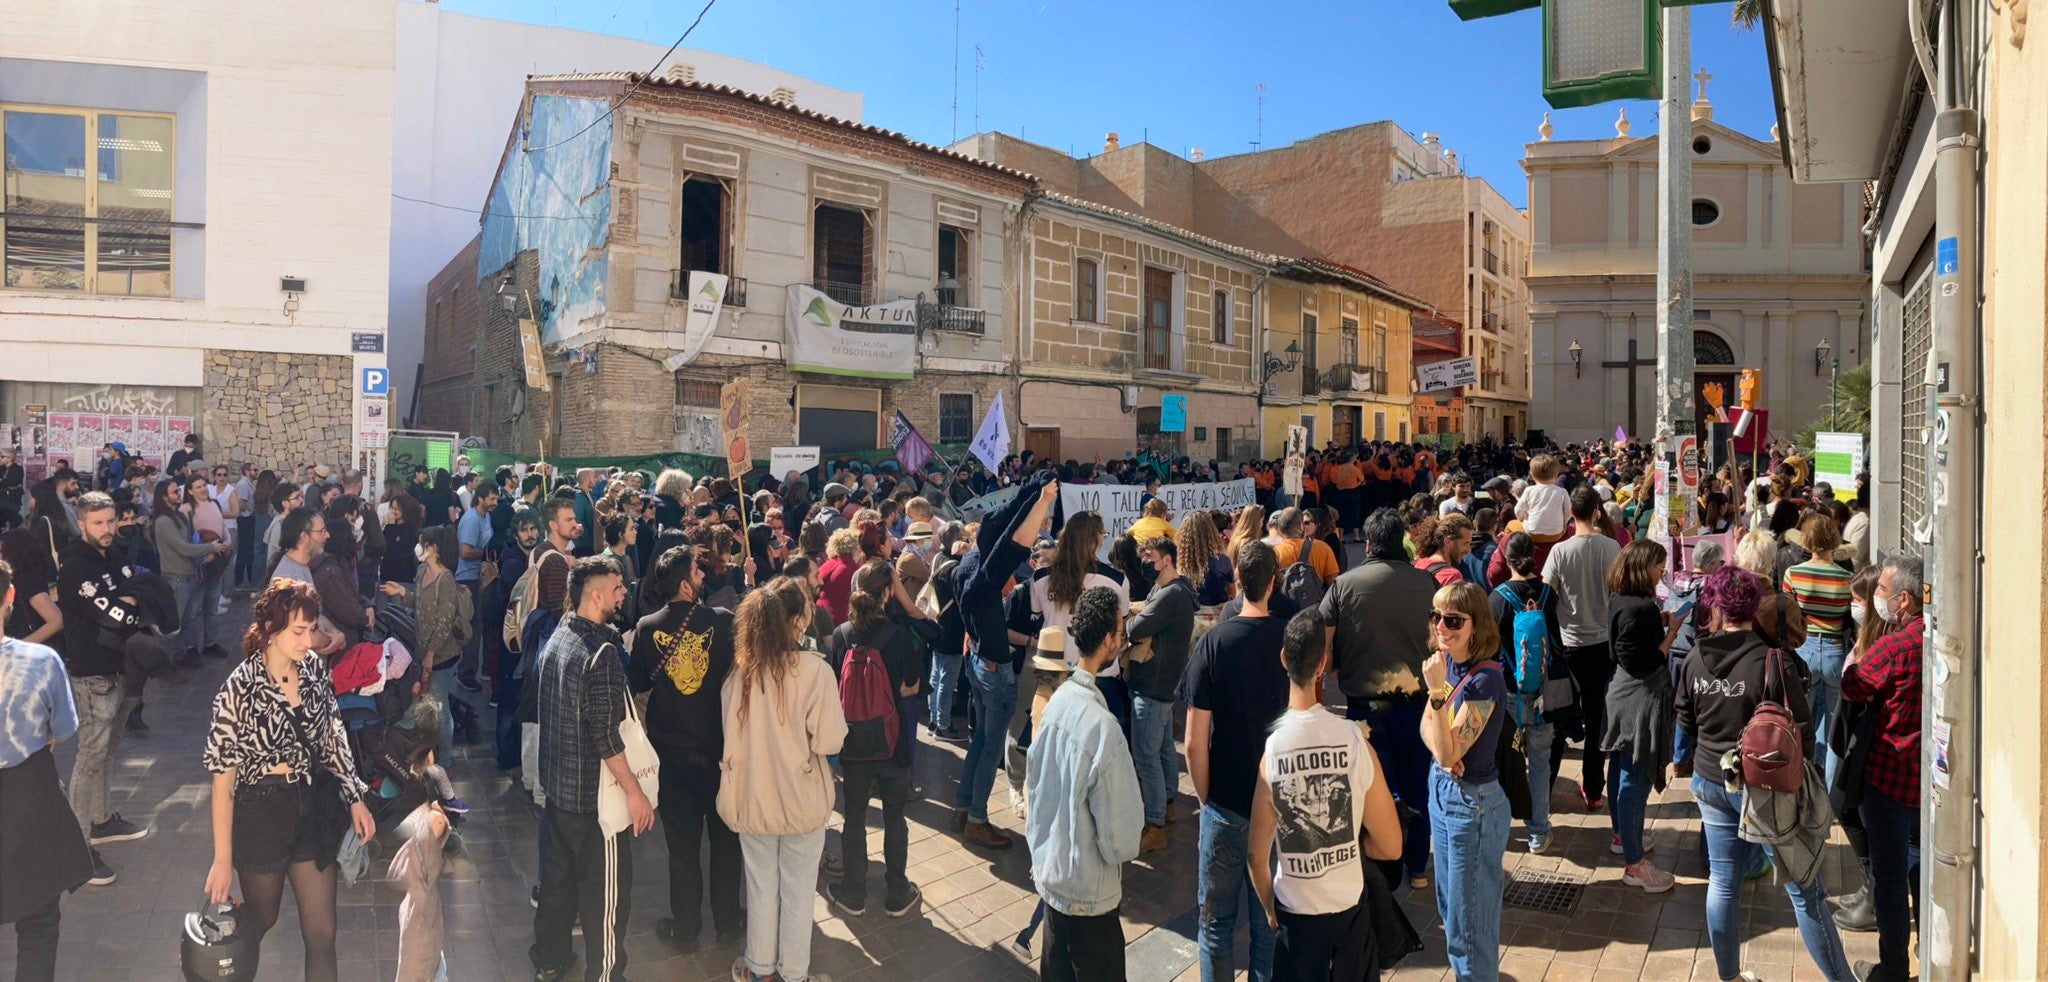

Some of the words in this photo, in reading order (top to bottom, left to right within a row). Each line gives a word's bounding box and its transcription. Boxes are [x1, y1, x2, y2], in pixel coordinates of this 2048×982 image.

[367, 371, 383, 391] P
[1081, 491, 1100, 512] NO
[1166, 491, 1176, 512] EL
[1181, 489, 1197, 510] REG
